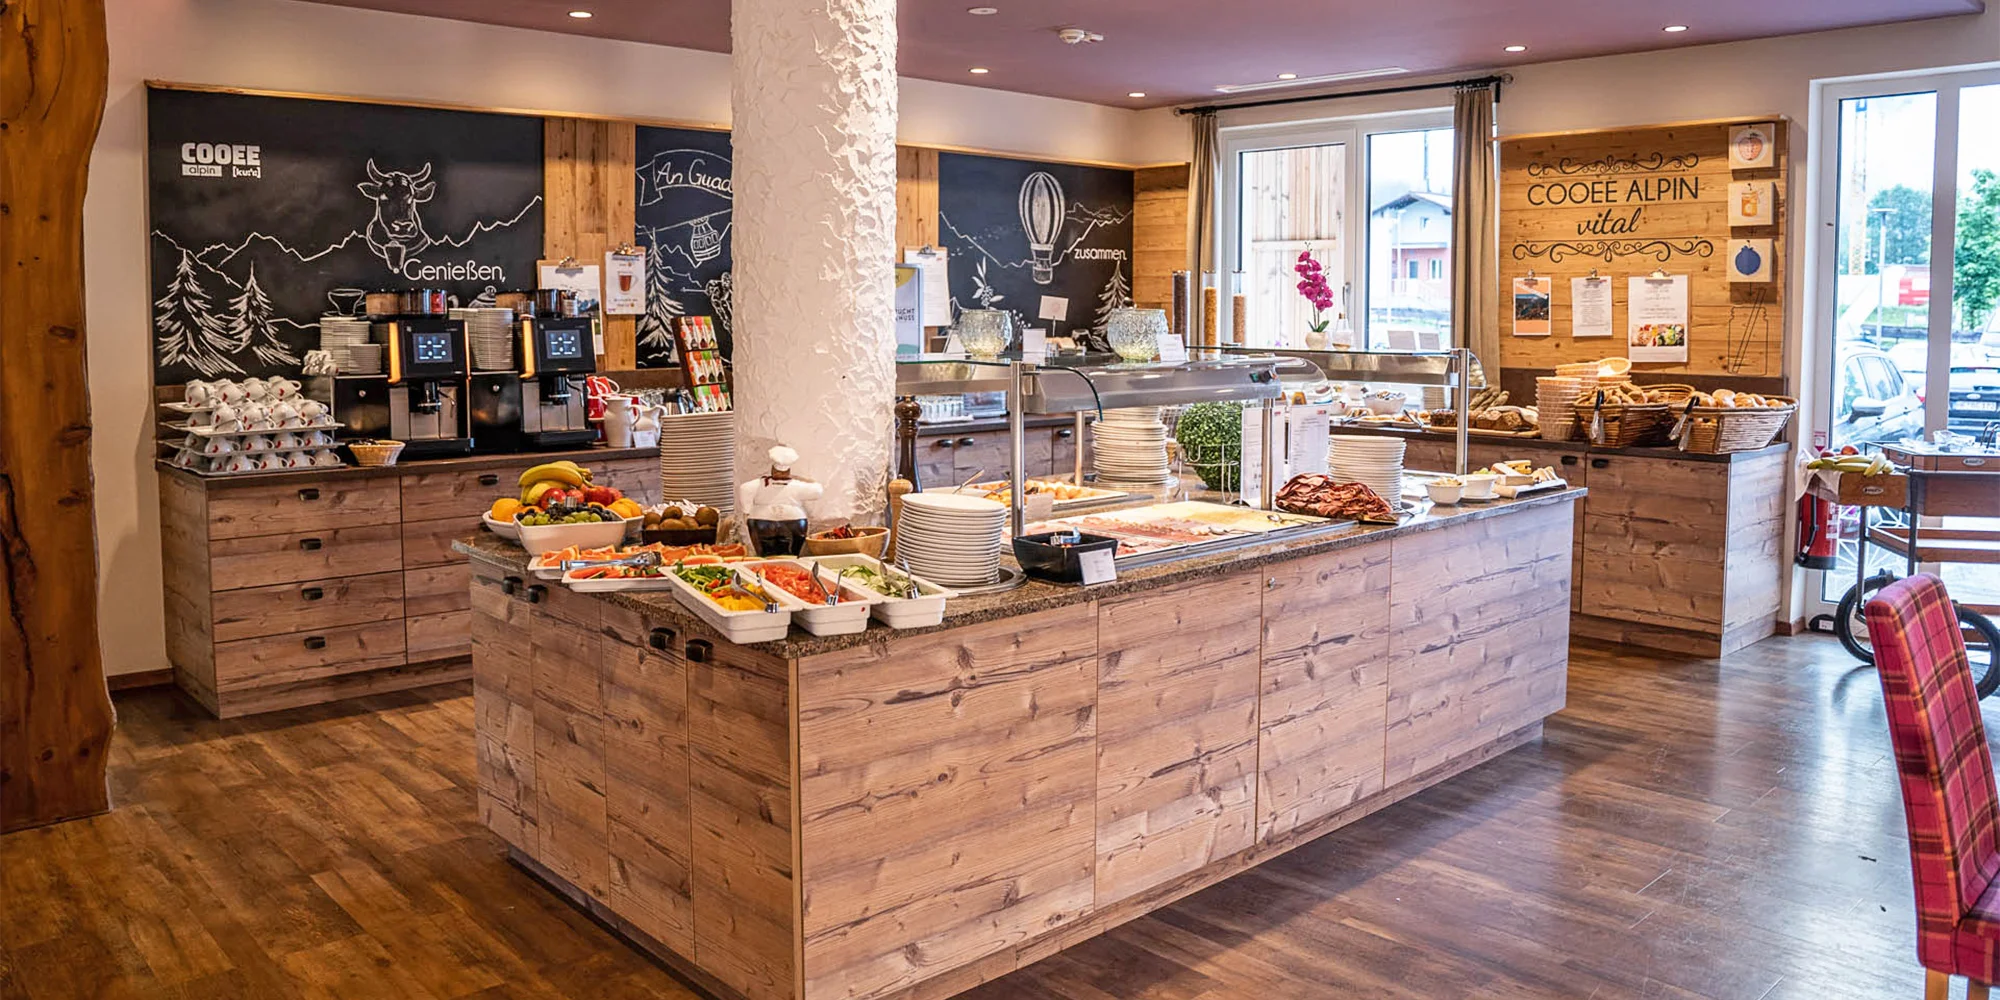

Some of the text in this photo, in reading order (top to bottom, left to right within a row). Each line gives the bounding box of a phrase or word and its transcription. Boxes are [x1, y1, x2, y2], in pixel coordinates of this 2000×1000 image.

[181, 142, 261, 166] COOEE
[656, 161, 684, 185] An
[1527, 176, 1699, 206] COOEE ALPIN
[1577, 207, 1642, 236] vital
[403, 258, 506, 283] Genießen,
